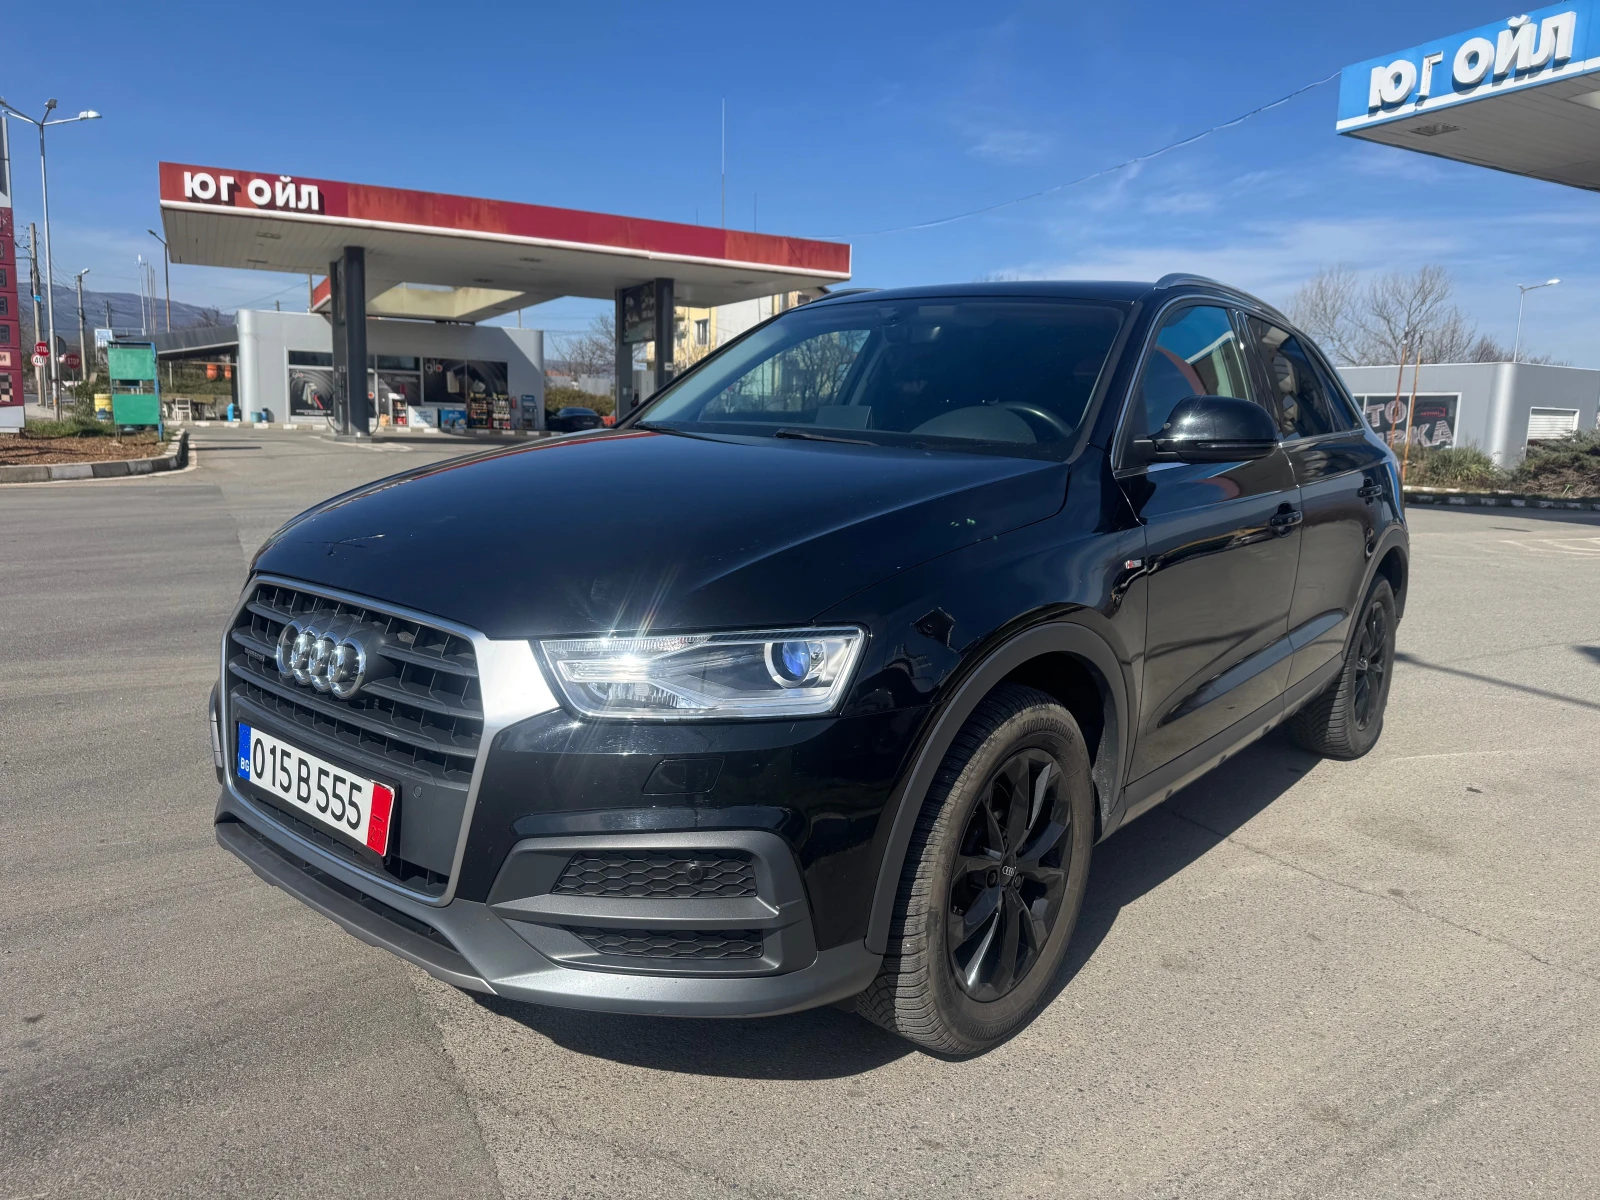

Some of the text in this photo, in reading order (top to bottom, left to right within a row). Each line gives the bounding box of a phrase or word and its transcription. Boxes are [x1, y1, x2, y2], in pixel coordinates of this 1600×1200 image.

[1368, 10, 1577, 109] ЮГ ОЙЛ
[184, 171, 320, 211] ЮГ ОЙЛ
[67, 357, 80, 366] STOP
[240, 737, 362, 831] BG 015B555
